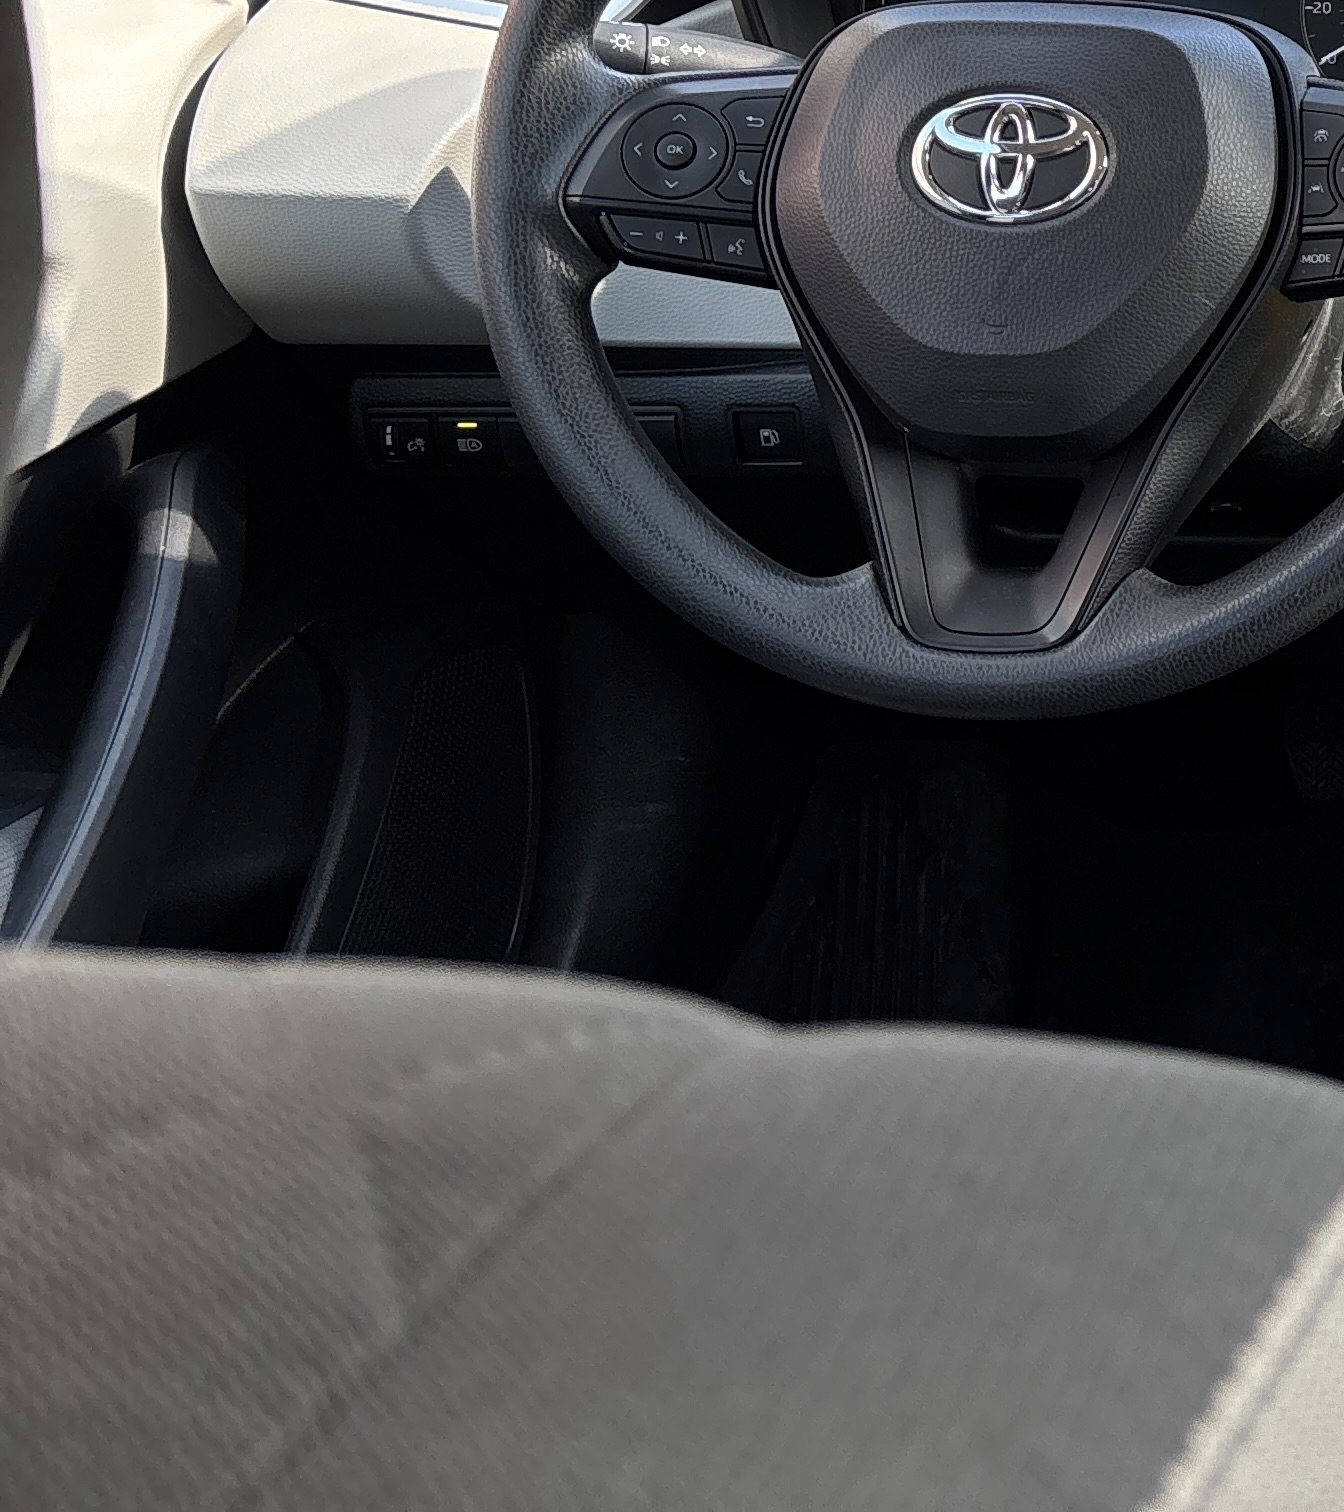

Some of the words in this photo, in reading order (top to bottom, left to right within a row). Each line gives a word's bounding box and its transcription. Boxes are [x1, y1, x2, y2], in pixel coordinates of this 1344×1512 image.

[1313, 1, 1332, 15] 20
[666, 144, 684, 155] OK
[1301, 253, 1332, 264] MODE
[988, 390, 1035, 403] AIRBAG
